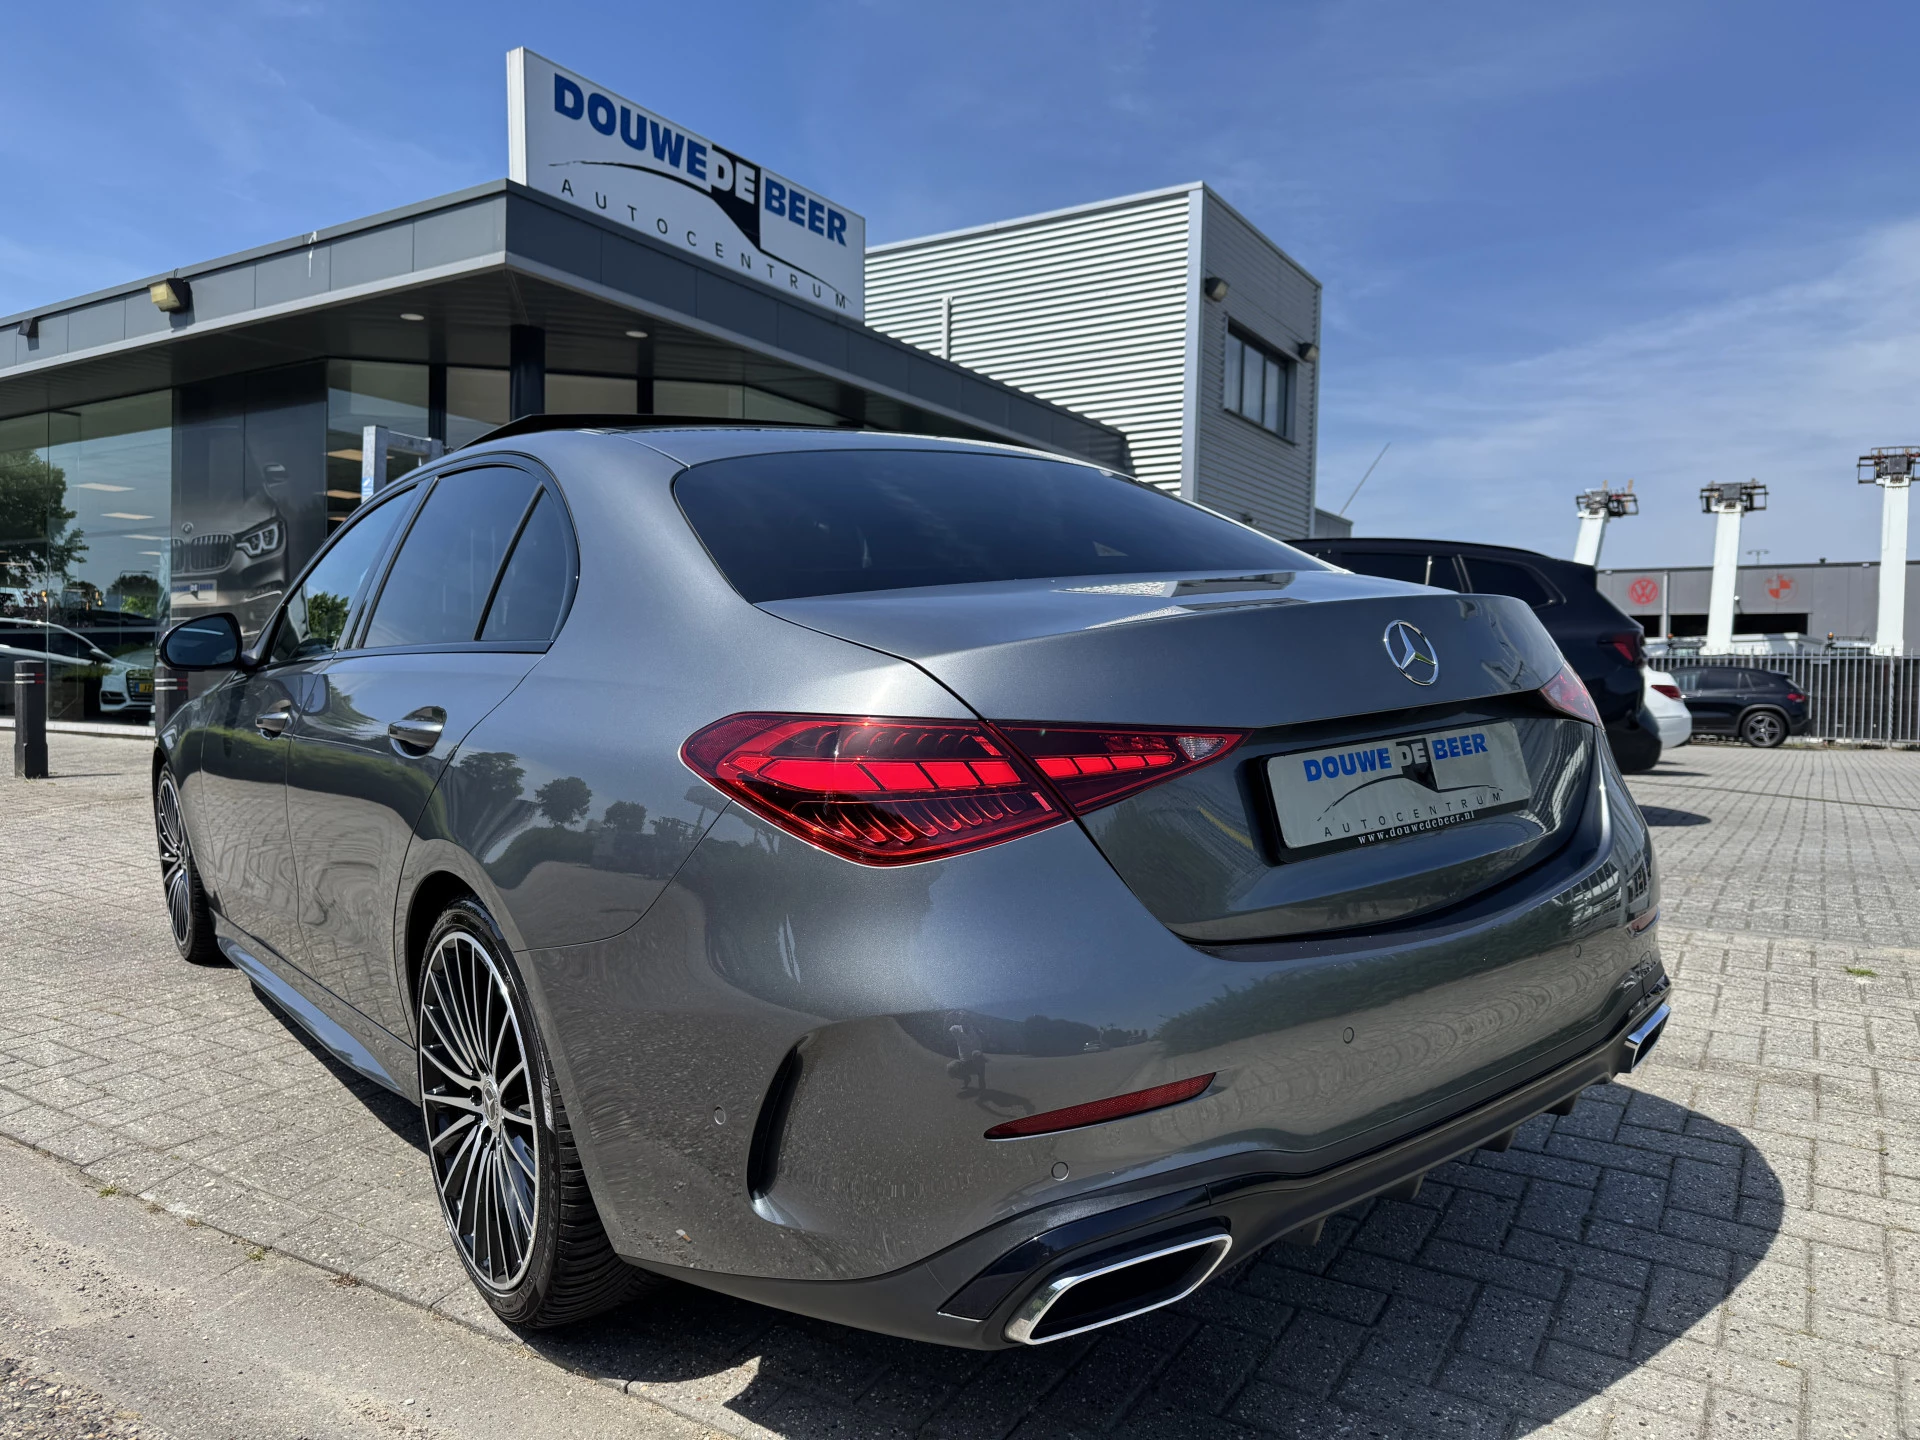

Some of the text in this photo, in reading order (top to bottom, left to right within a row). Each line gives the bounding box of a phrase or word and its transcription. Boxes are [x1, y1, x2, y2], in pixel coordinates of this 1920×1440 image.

[554, 72, 847, 247] DOUWE DE BEER
[561, 178, 846, 310] AUTOCENTRUM
[1303, 733, 1489, 782] DOUWE DE BEER
[1324, 792, 1501, 838] AUTOCENTRUM
[1357, 810, 1475, 845] www.douwedebeer.nl
